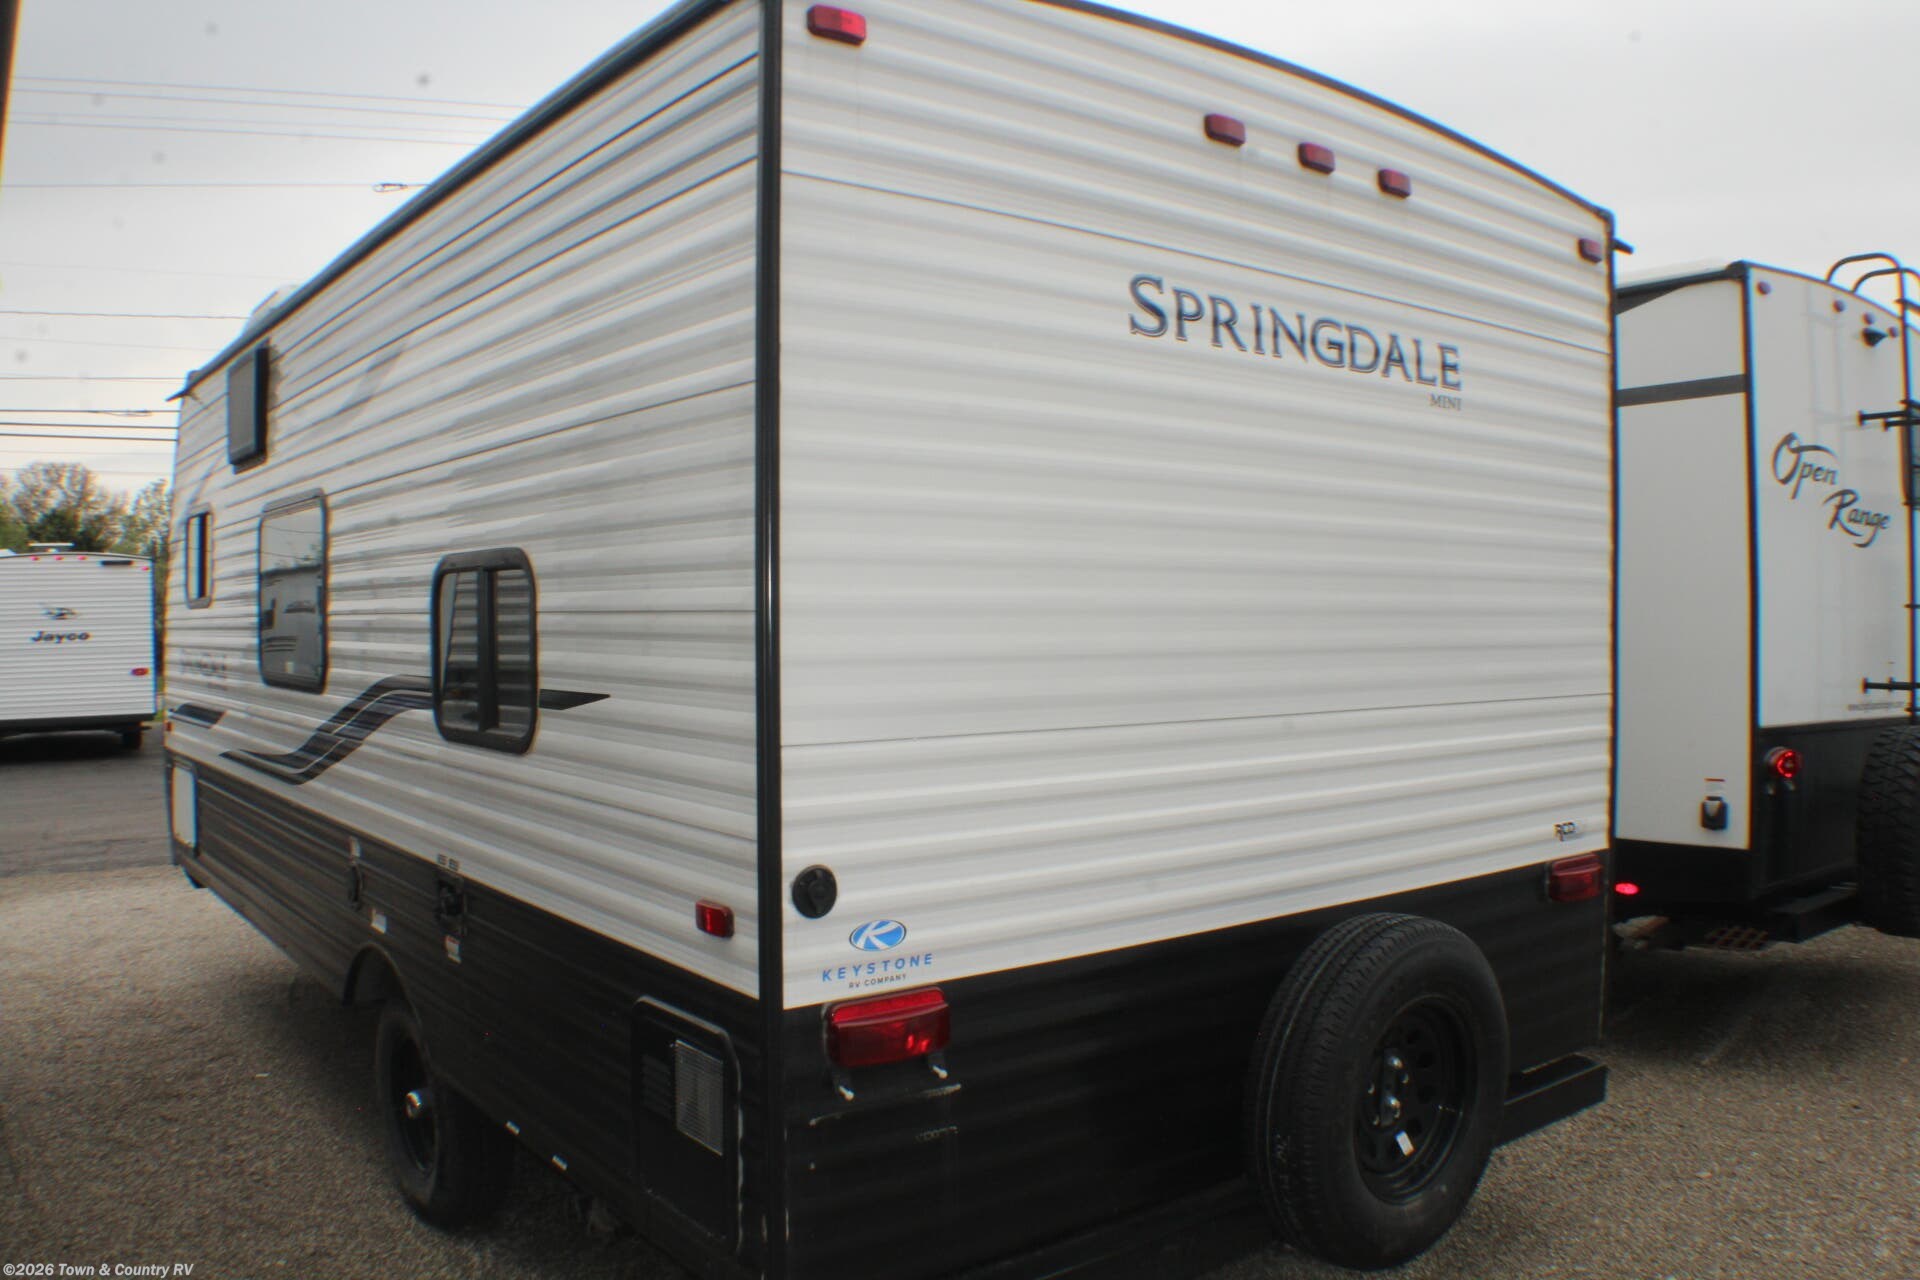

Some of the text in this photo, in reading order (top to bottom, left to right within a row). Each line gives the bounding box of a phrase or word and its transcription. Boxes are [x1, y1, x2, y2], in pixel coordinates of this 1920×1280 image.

[1129, 273, 1462, 391] SPRINGDALE
[1430, 393, 1462, 411] MINI
[1772, 432, 1838, 500] Open
[1822, 489, 1890, 548] Range
[31, 630, 91, 643] Jayco
[822, 953, 933, 982] KEYSTONE
[864, 974, 907, 987] COMPANY
